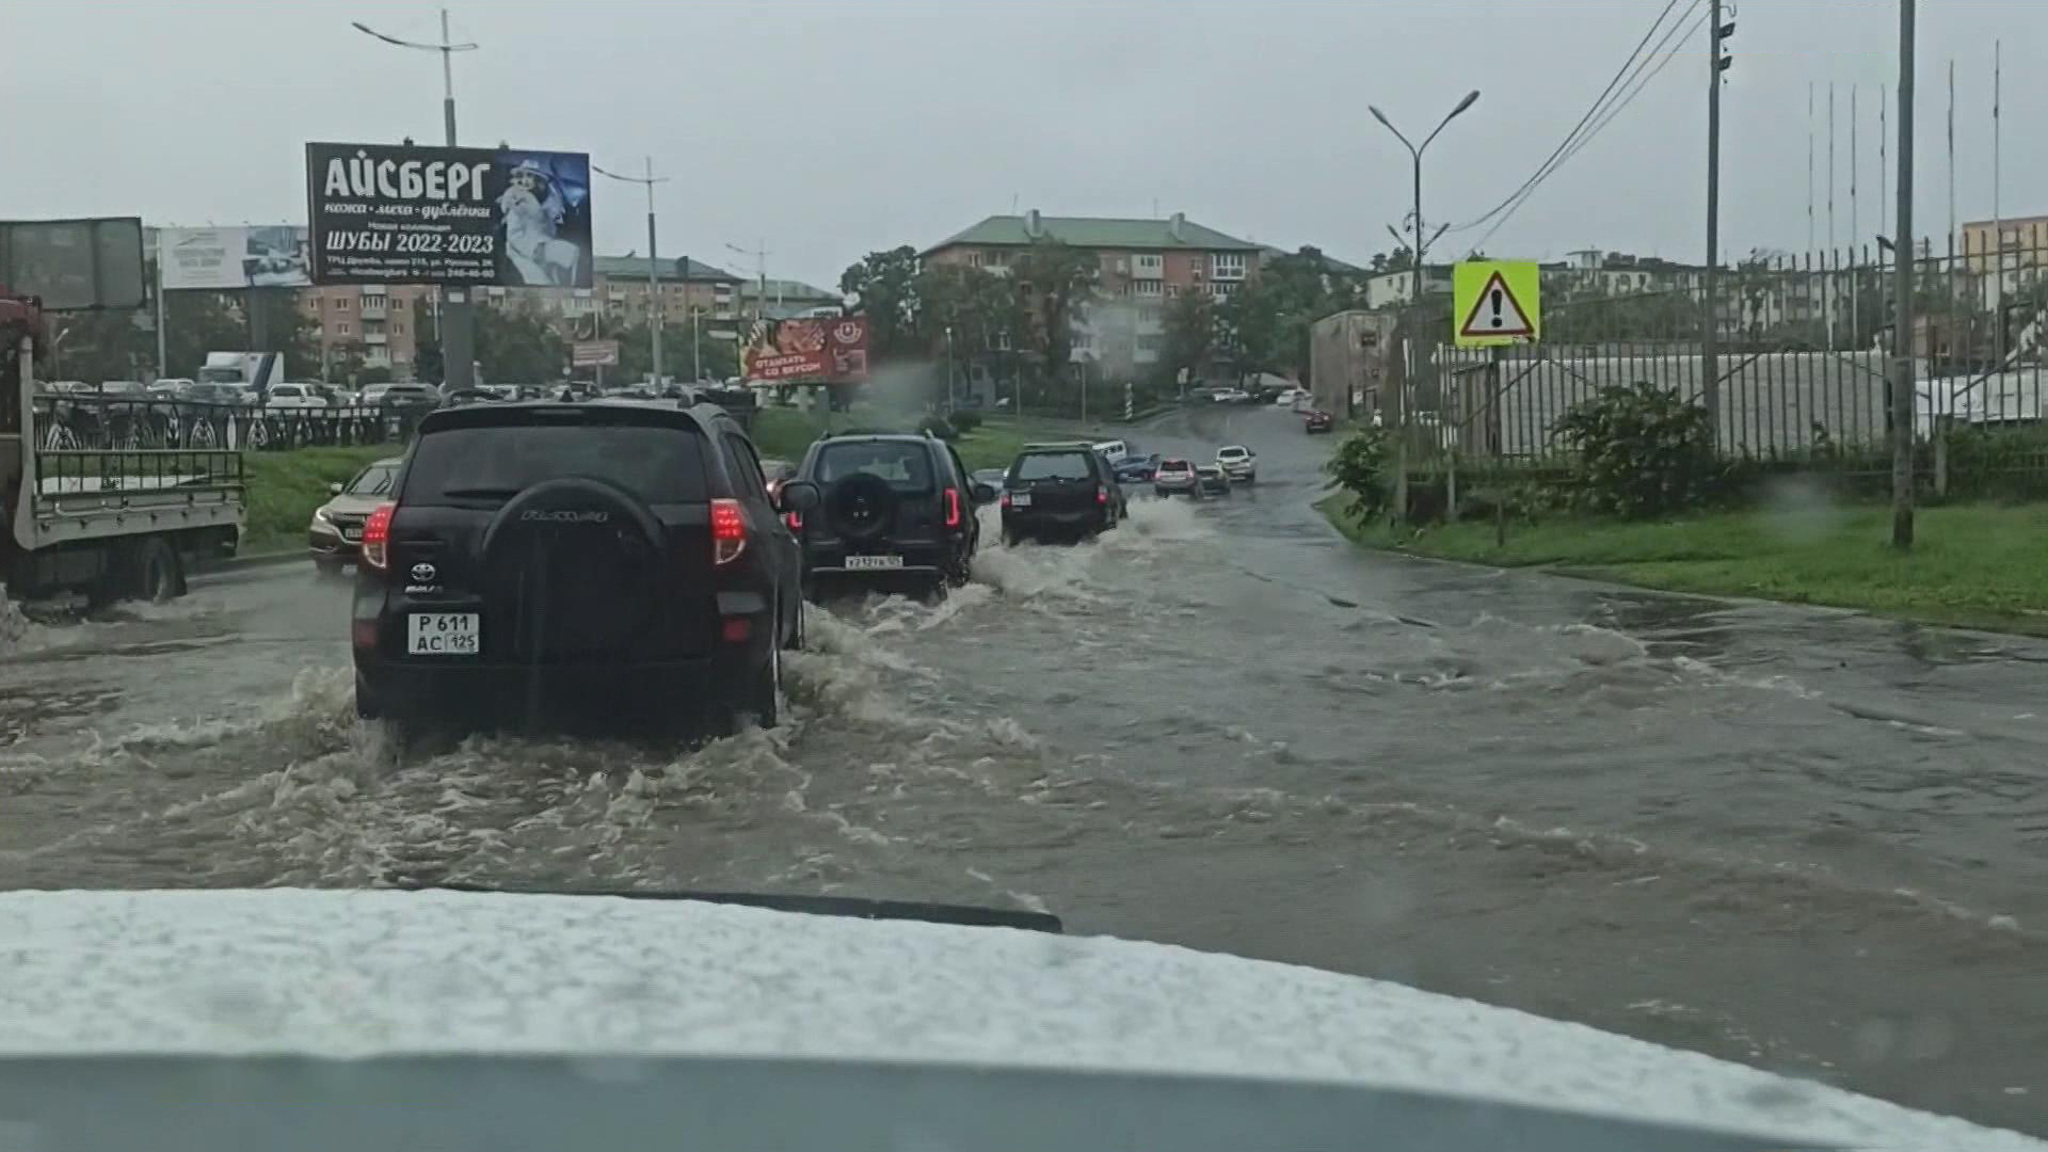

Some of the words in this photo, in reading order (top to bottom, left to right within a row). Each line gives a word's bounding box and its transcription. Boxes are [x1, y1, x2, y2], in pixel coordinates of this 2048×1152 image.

[324, 149, 491, 200] АЙСБЕРГ
[326, 231, 391, 250] ШУБЫ
[396, 233, 493, 253] 2022-2023
[419, 615, 431, 631] Р
[438, 615, 468, 631] 611
[417, 635, 441, 651] АС
[451, 634, 475, 648] 125
